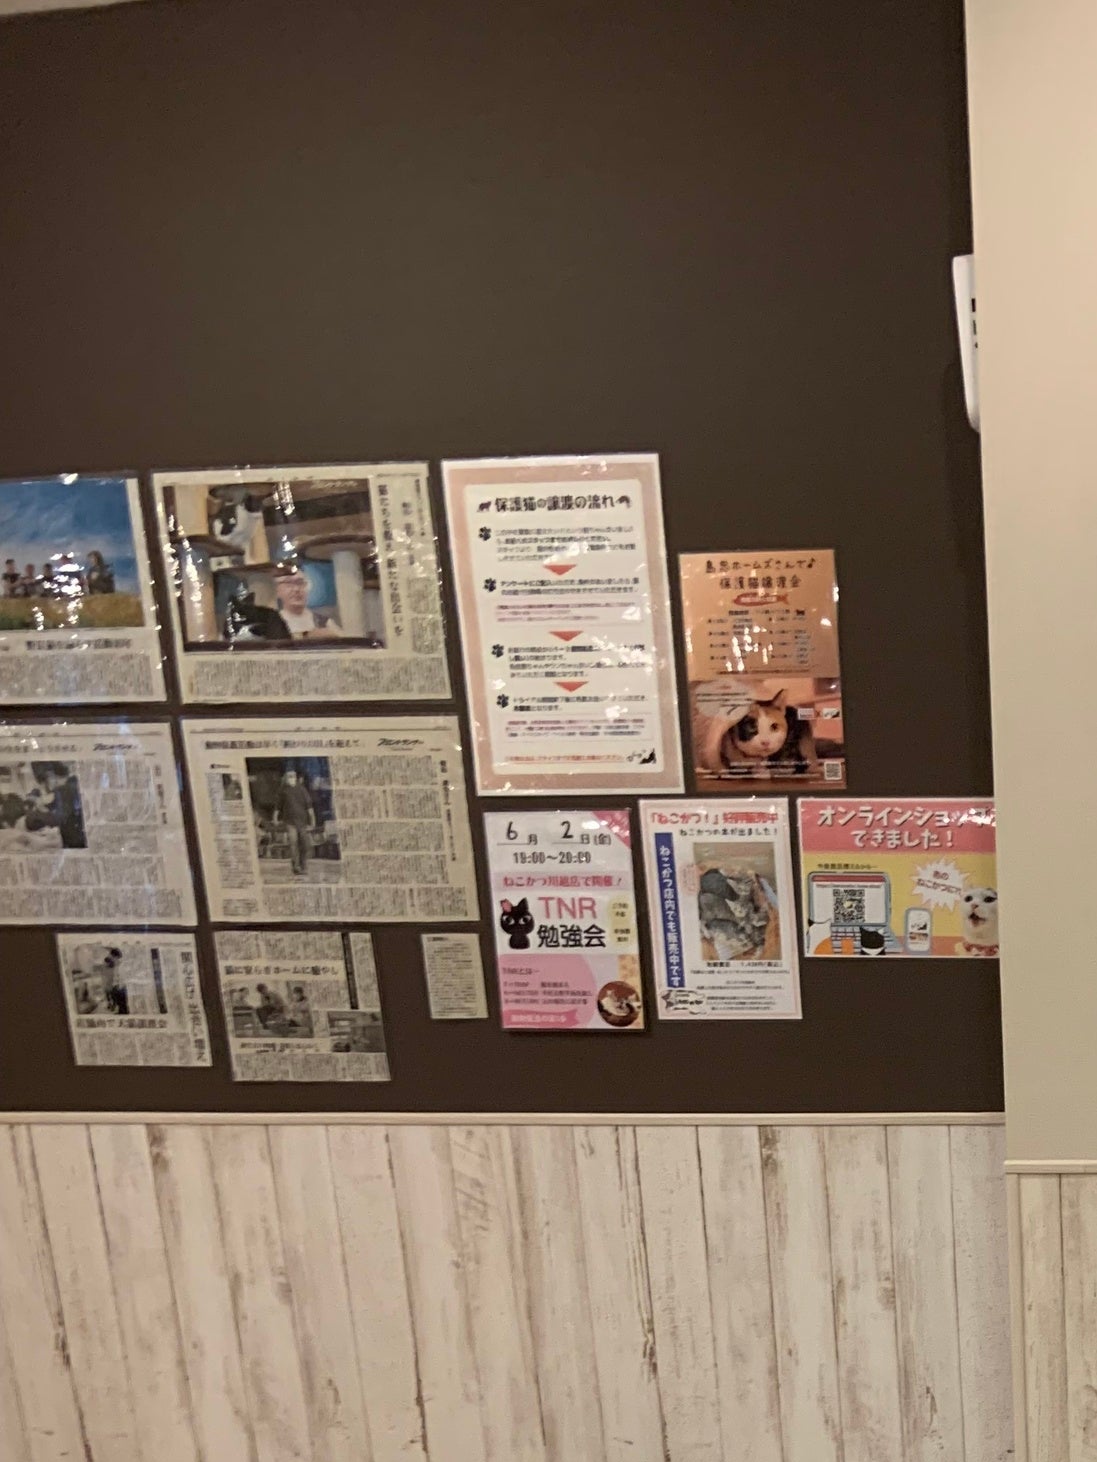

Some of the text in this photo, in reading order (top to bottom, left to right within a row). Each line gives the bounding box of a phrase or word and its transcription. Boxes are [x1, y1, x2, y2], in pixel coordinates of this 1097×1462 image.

[537, 896, 598, 920] TNR
[536, 924, 606, 948] 勉強会
